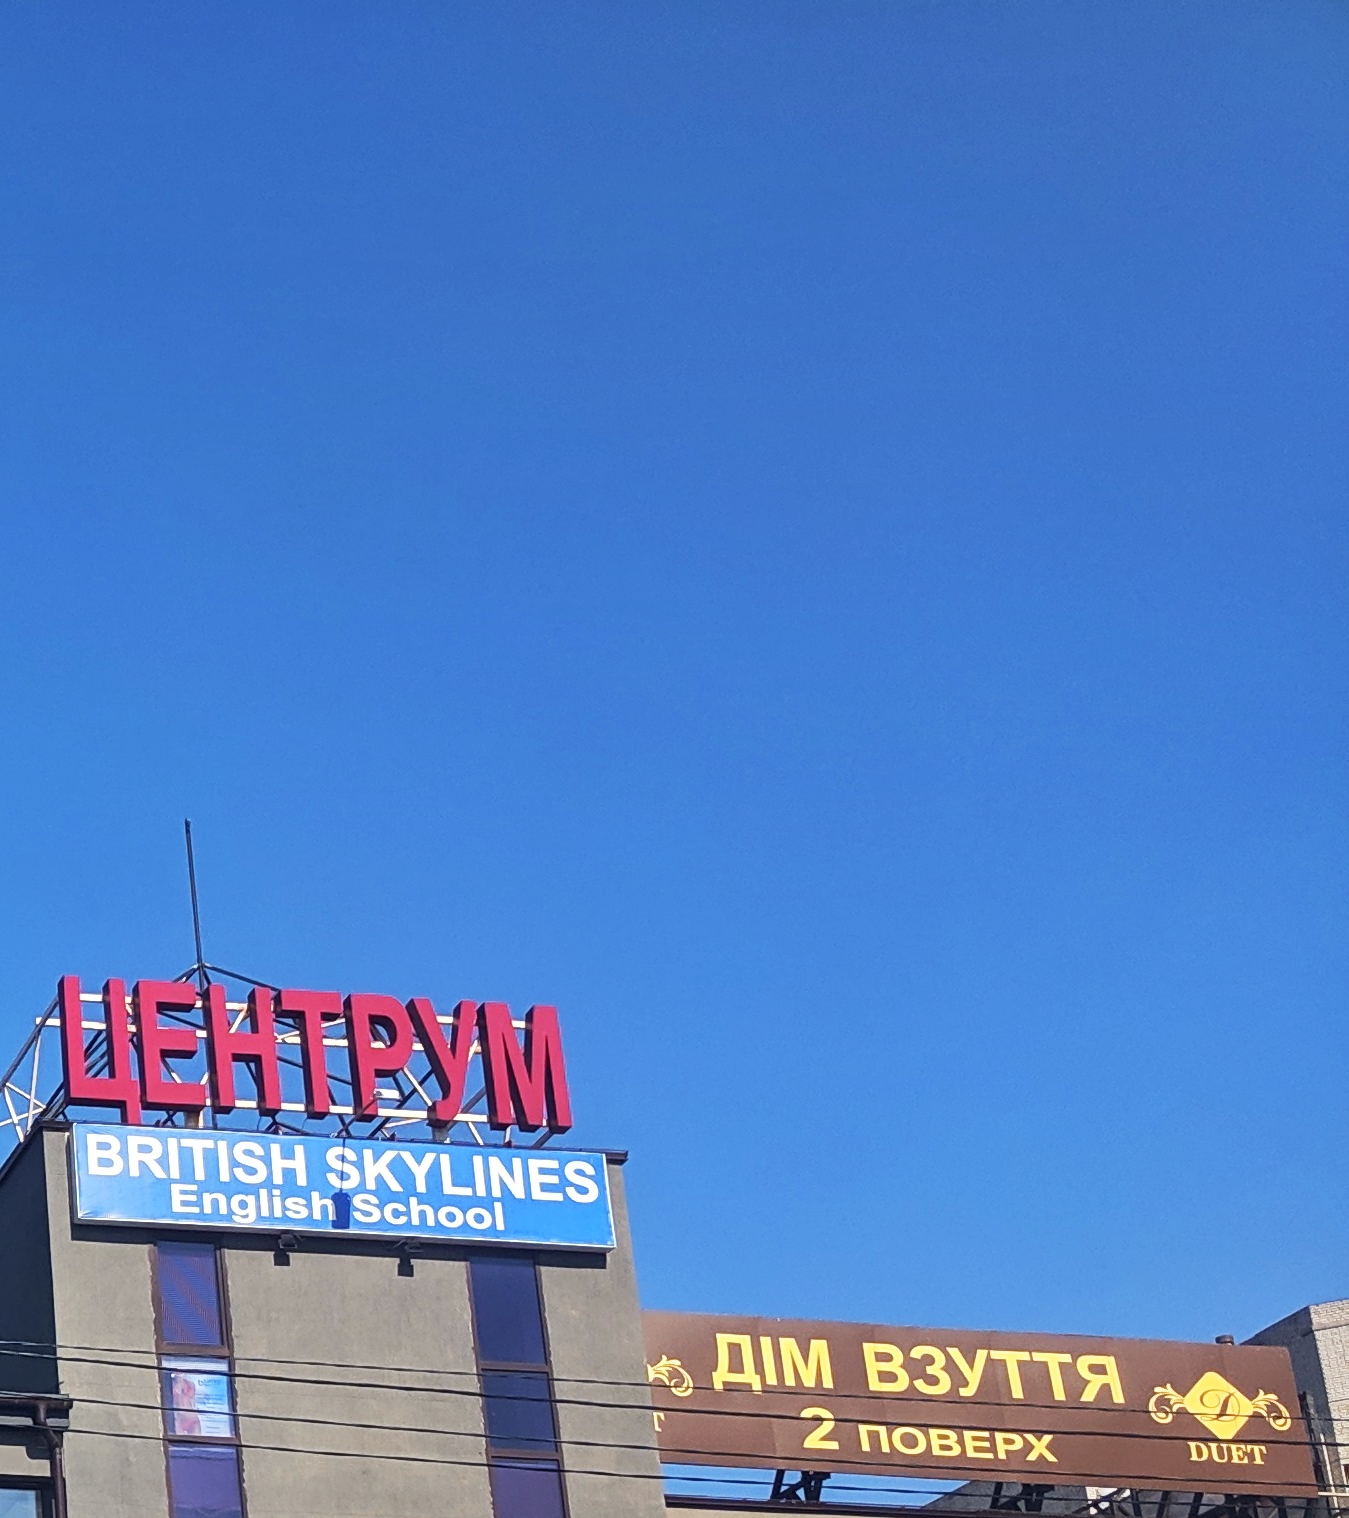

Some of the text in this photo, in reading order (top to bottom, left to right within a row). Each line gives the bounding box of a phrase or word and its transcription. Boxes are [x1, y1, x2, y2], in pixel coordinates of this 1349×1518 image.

[58, 975, 572, 1134] ЦЕНТРУМ
[86, 1133, 599, 1204] BRITISH SKYLINES
[170, 1182, 505, 1231] English School
[712, 1332, 1126, 1404] ДІМ ВЗУТТЯ
[802, 1407, 1058, 1463] 2 ПОВЕРХ
[1188, 1441, 1267, 1466] DUET
